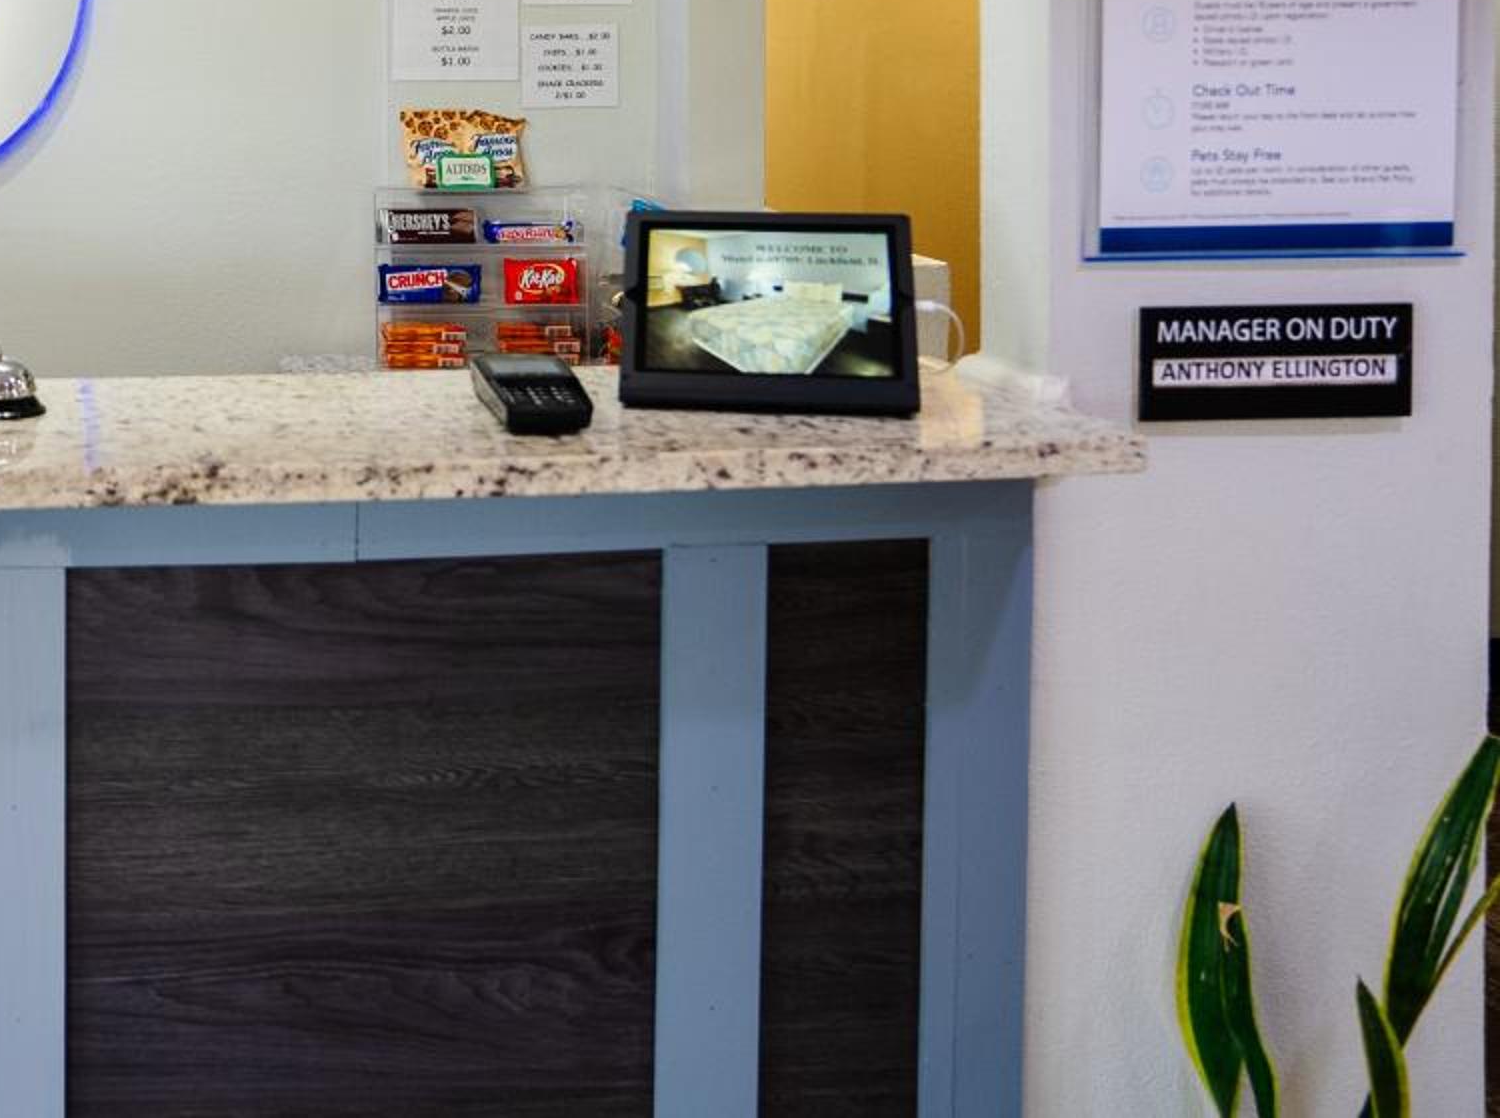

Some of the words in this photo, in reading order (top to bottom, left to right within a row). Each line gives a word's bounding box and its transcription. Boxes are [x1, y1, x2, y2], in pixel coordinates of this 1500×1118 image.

[441, 25, 471, 35] $2.00
[441, 57, 471, 67] $1.00
[1192, 84, 1231, 96] Check
[1236, 84, 1260, 96] Out
[1265, 83, 1296, 96] Time
[1191, 148, 1218, 161] Pets
[1222, 148, 1249, 163] Stay
[1253, 147, 1282, 160] Free
[446, 164, 487, 175] ALTOIDS
[396, 213, 450, 231] HERSHEY'S
[387, 271, 445, 289] CRUNCH
[1157, 319, 1281, 343] MANAGER
[1285, 317, 1323, 341] ON
[1330, 316, 1397, 340] DUTY
[1161, 360, 1265, 381] ANTHONY
[1272, 358, 1386, 379] ELLINGTON
